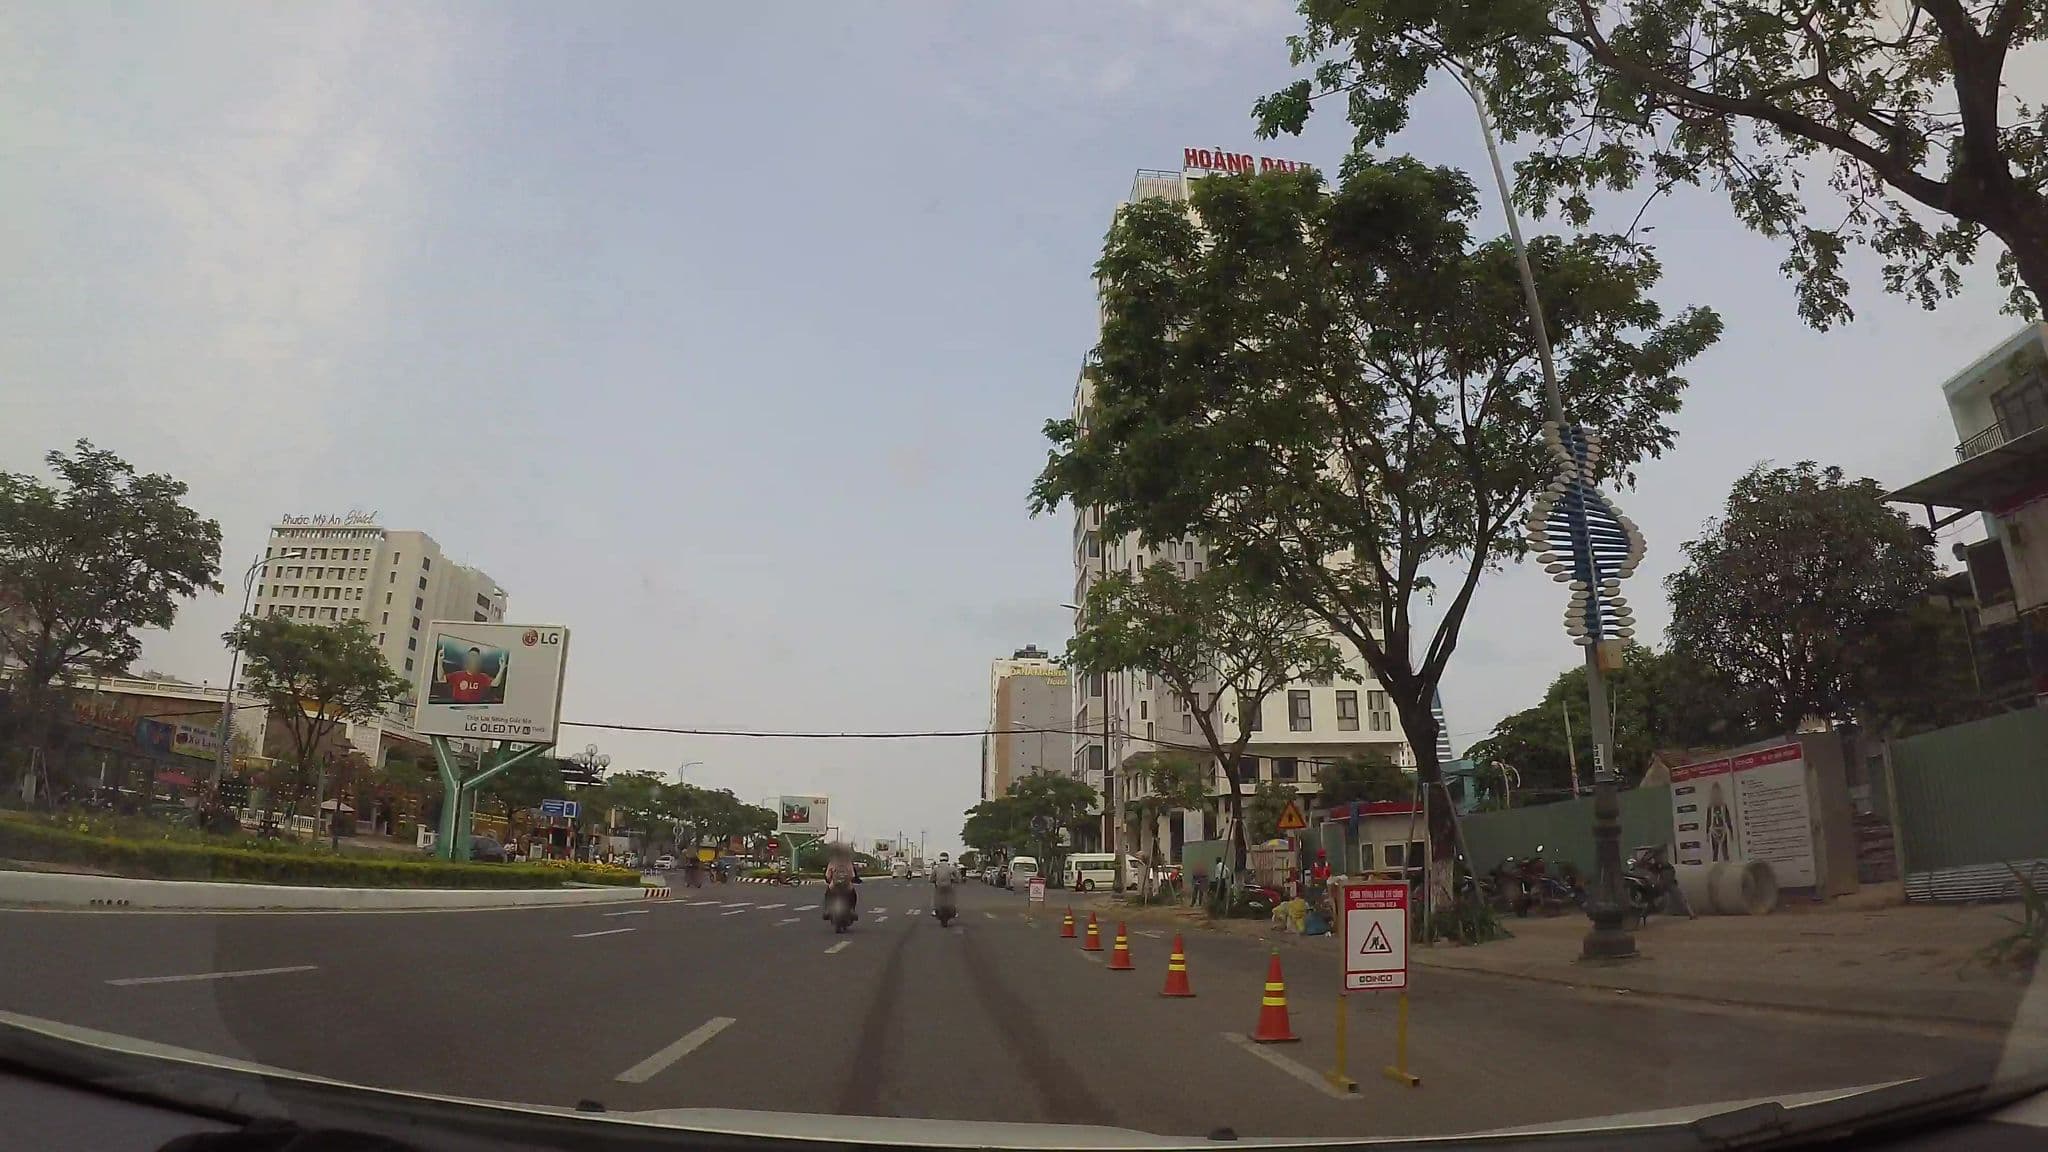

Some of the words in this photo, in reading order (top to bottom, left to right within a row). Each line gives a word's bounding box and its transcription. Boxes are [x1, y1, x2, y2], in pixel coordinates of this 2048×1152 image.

[541, 633, 558, 645] LG
[469, 682, 479, 690] LG
[465, 723, 477, 732] LG
[480, 723, 505, 734] OLED
[508, 725, 521, 734] TV
